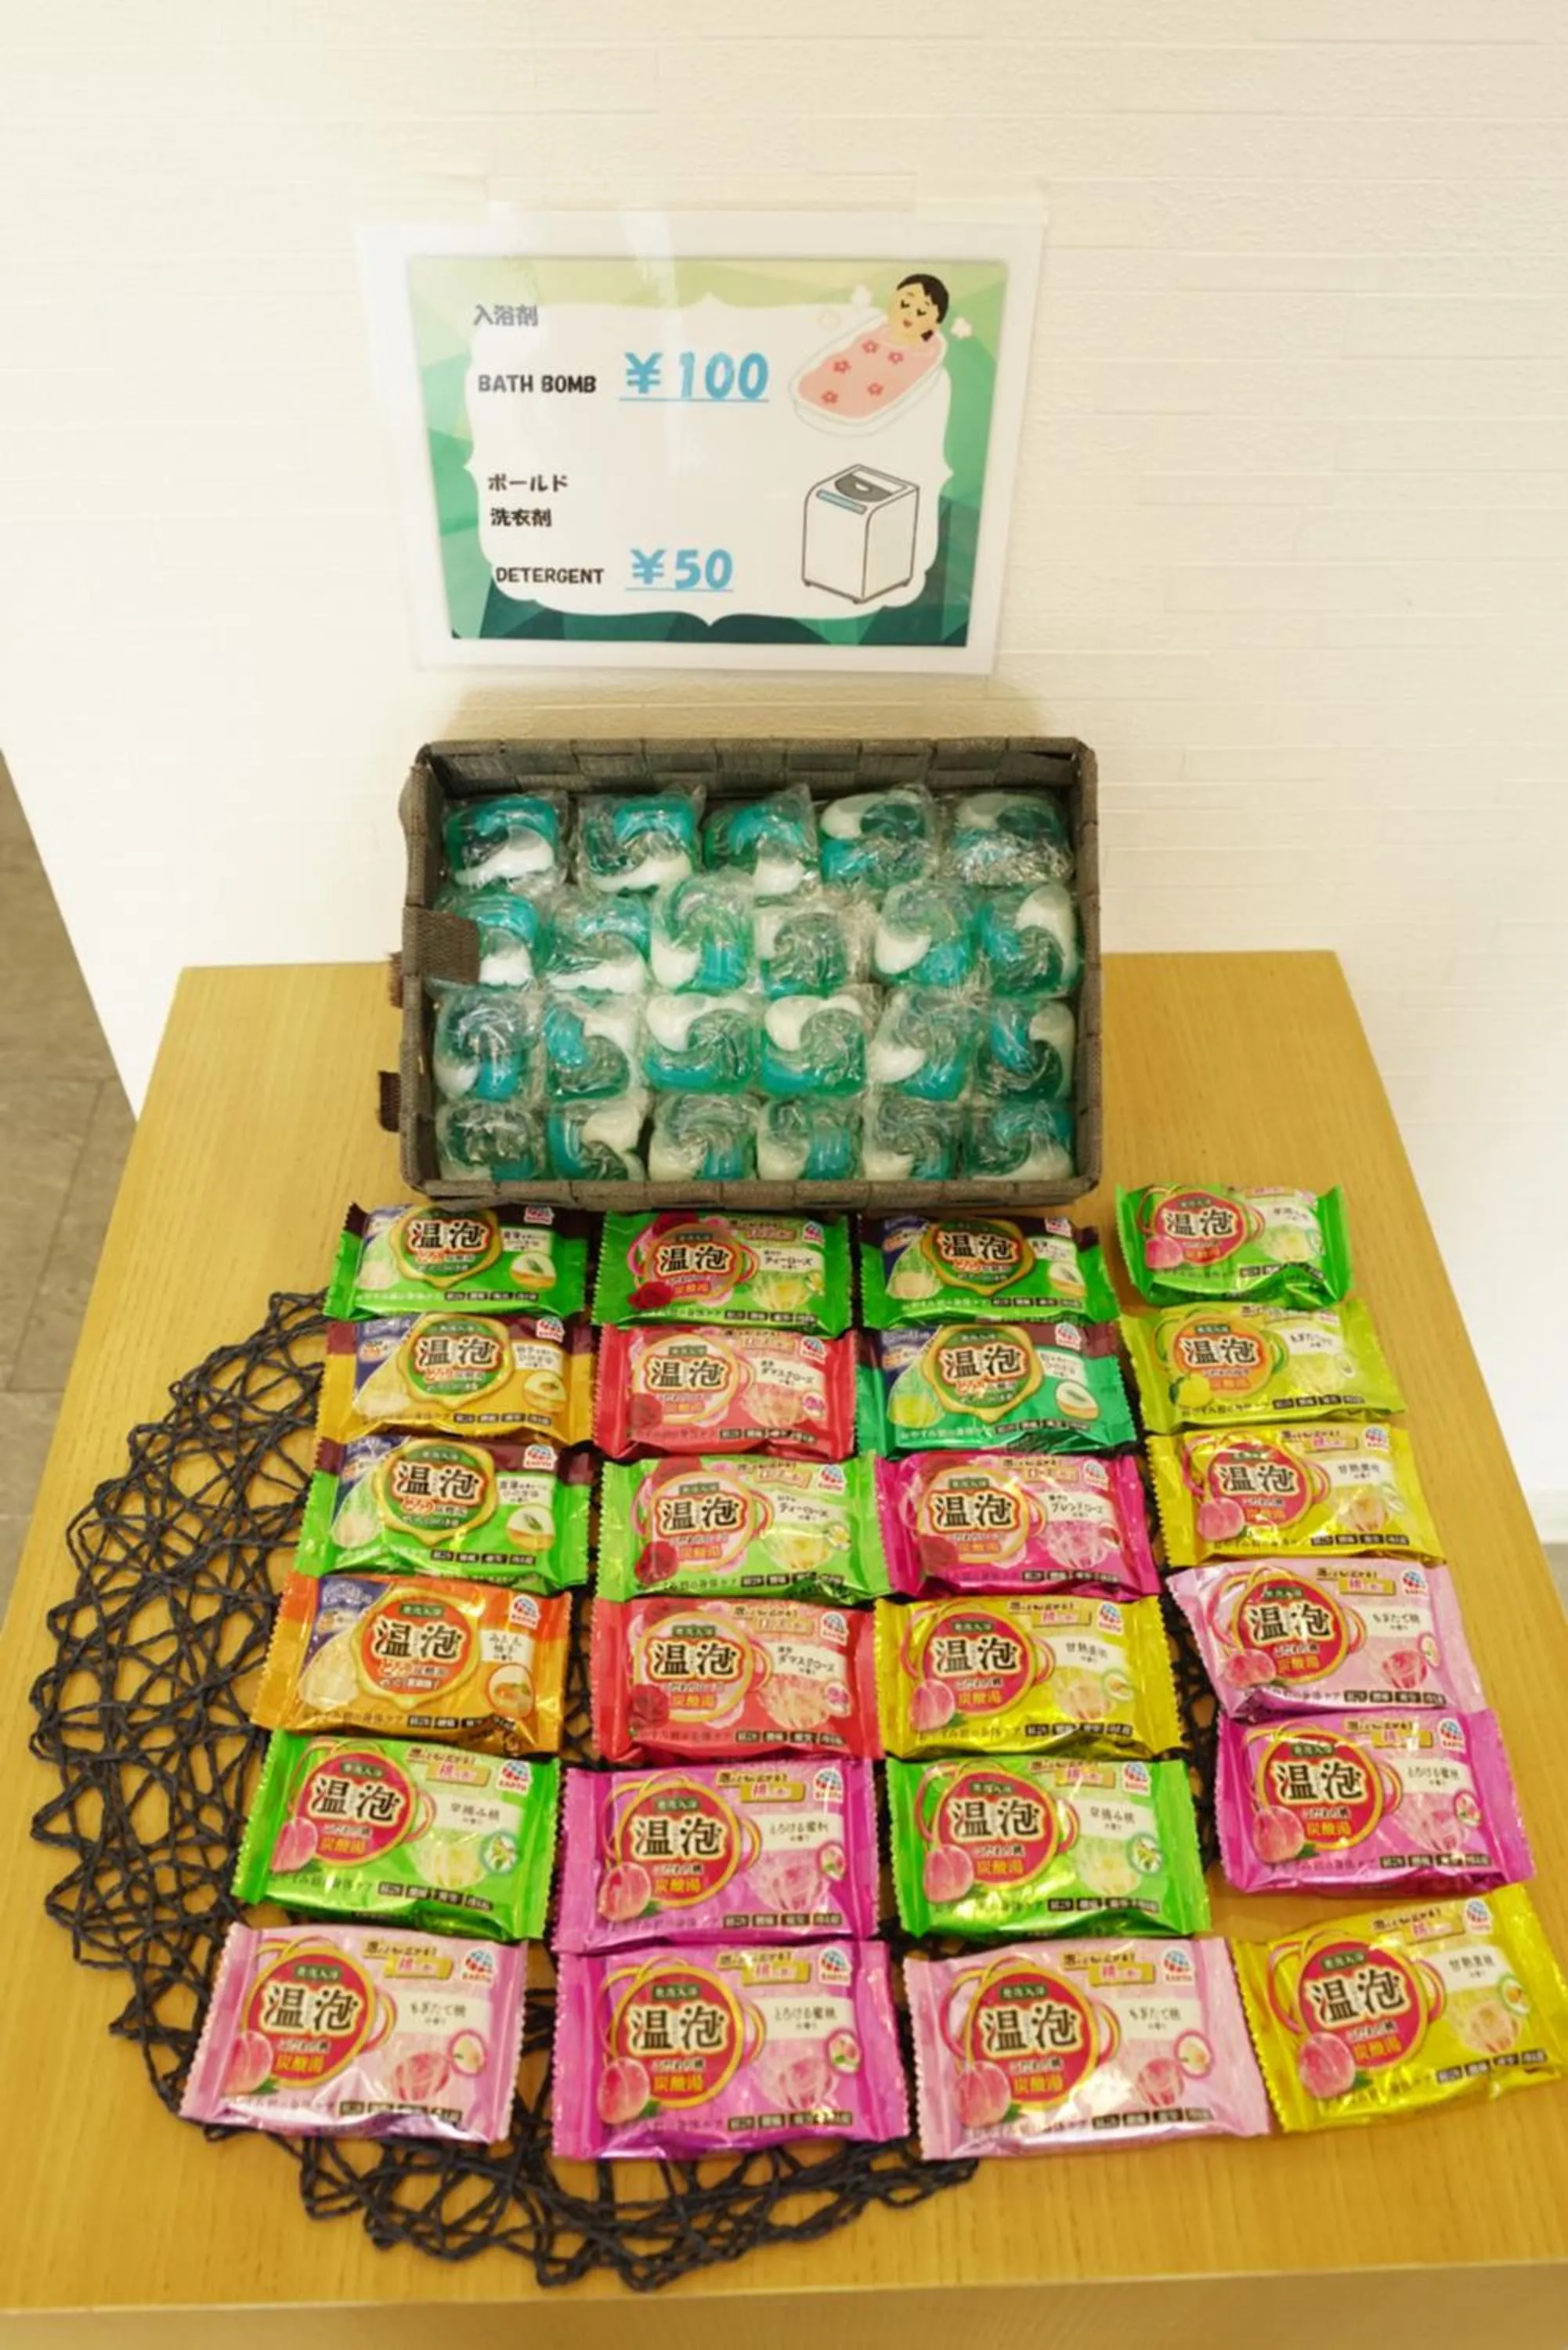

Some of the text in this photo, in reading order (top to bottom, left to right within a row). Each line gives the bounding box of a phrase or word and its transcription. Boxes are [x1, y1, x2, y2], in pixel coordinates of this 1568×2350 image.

[473, 305, 539, 327] 入浴剤
[478, 374, 597, 393] BATH BOMB
[624, 351, 770, 400] ¥100
[488, 473, 568, 493] ボールド
[490, 508, 552, 527] 洗衣剤
[495, 566, 605, 584] DETERGENT
[630, 548, 733, 591] ¥50
[410, 1222, 485, 1249] 温泡
[1166, 1209, 1234, 1236] 温泡
[660, 1246, 728, 1271] 温泡
[942, 1234, 1013, 1260] 温泡
[419, 1339, 495, 1365] 温泡
[945, 1344, 1025, 1379] 温泡
[1184, 1336, 1256, 1364] 温泡
[651, 1360, 724, 1387] 温泡
[397, 1465, 479, 1500] 温泡
[1219, 1463, 1295, 1493] 温泡
[662, 1497, 739, 1530] 温泡
[935, 1494, 1012, 1527] 温泡
[1248, 1603, 1331, 1640] 温泡
[375, 1618, 462, 1659] 温泡
[937, 1637, 1018, 1672] 温泡
[655, 1643, 736, 1676] 温泡
[1276, 1762, 1363, 1801] 温泡
[311, 1777, 400, 1822] 温泡
[953, 1800, 1042, 1839] 温泡
[634, 1817, 724, 1856] 温泡
[266, 1983, 359, 2030] 温泡
[1312, 1967, 1407, 2023] 温泡
[631, 2006, 725, 2050] 温泡
[983, 2004, 1080, 2051] 温泡
